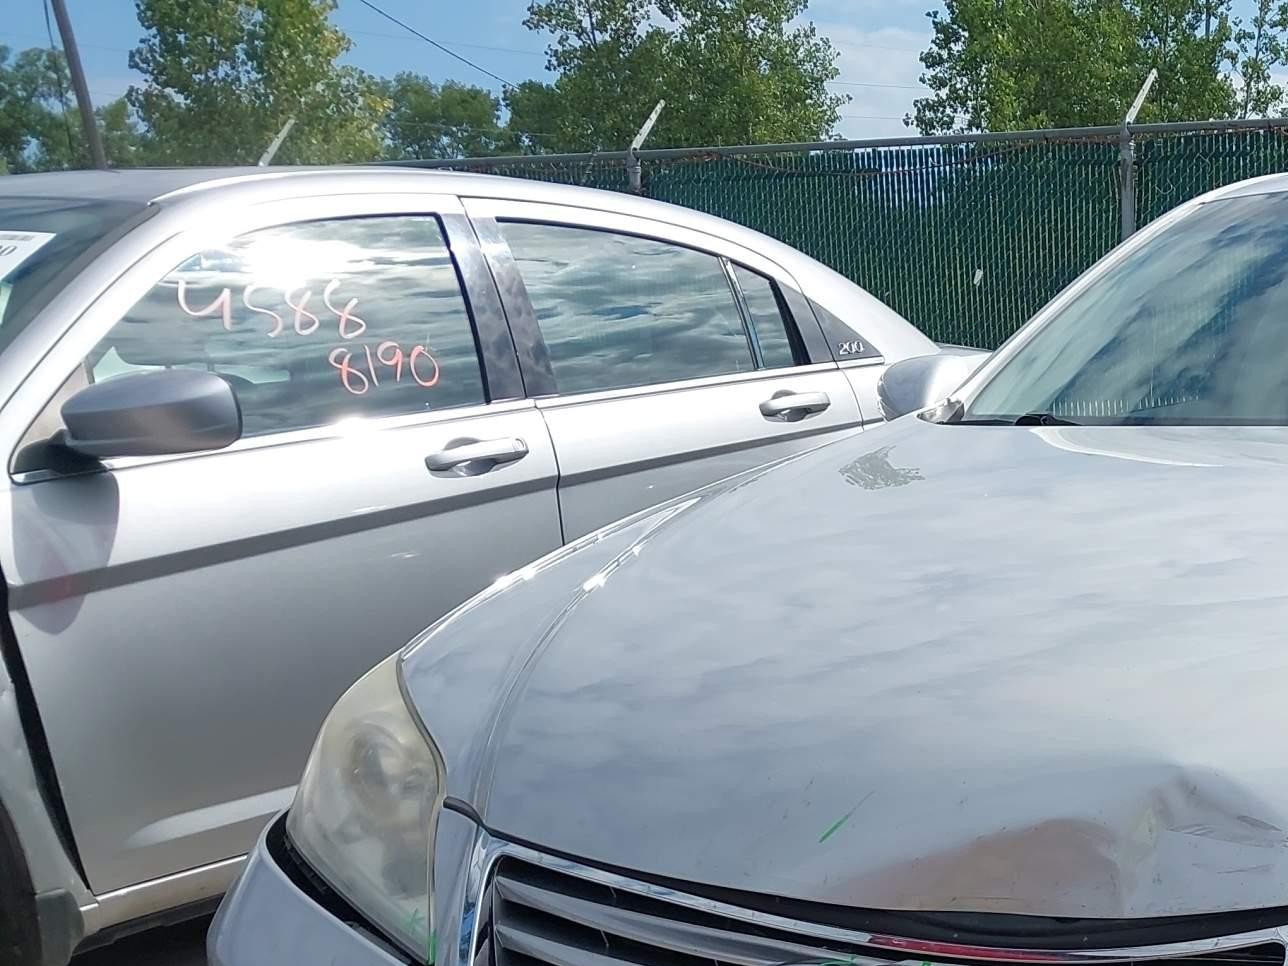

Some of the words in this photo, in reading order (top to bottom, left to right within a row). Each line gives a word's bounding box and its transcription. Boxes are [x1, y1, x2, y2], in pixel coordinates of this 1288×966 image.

[176, 278, 367, 339] 4588
[328, 341, 441, 395] 8190
[839, 341, 864, 355] 200
